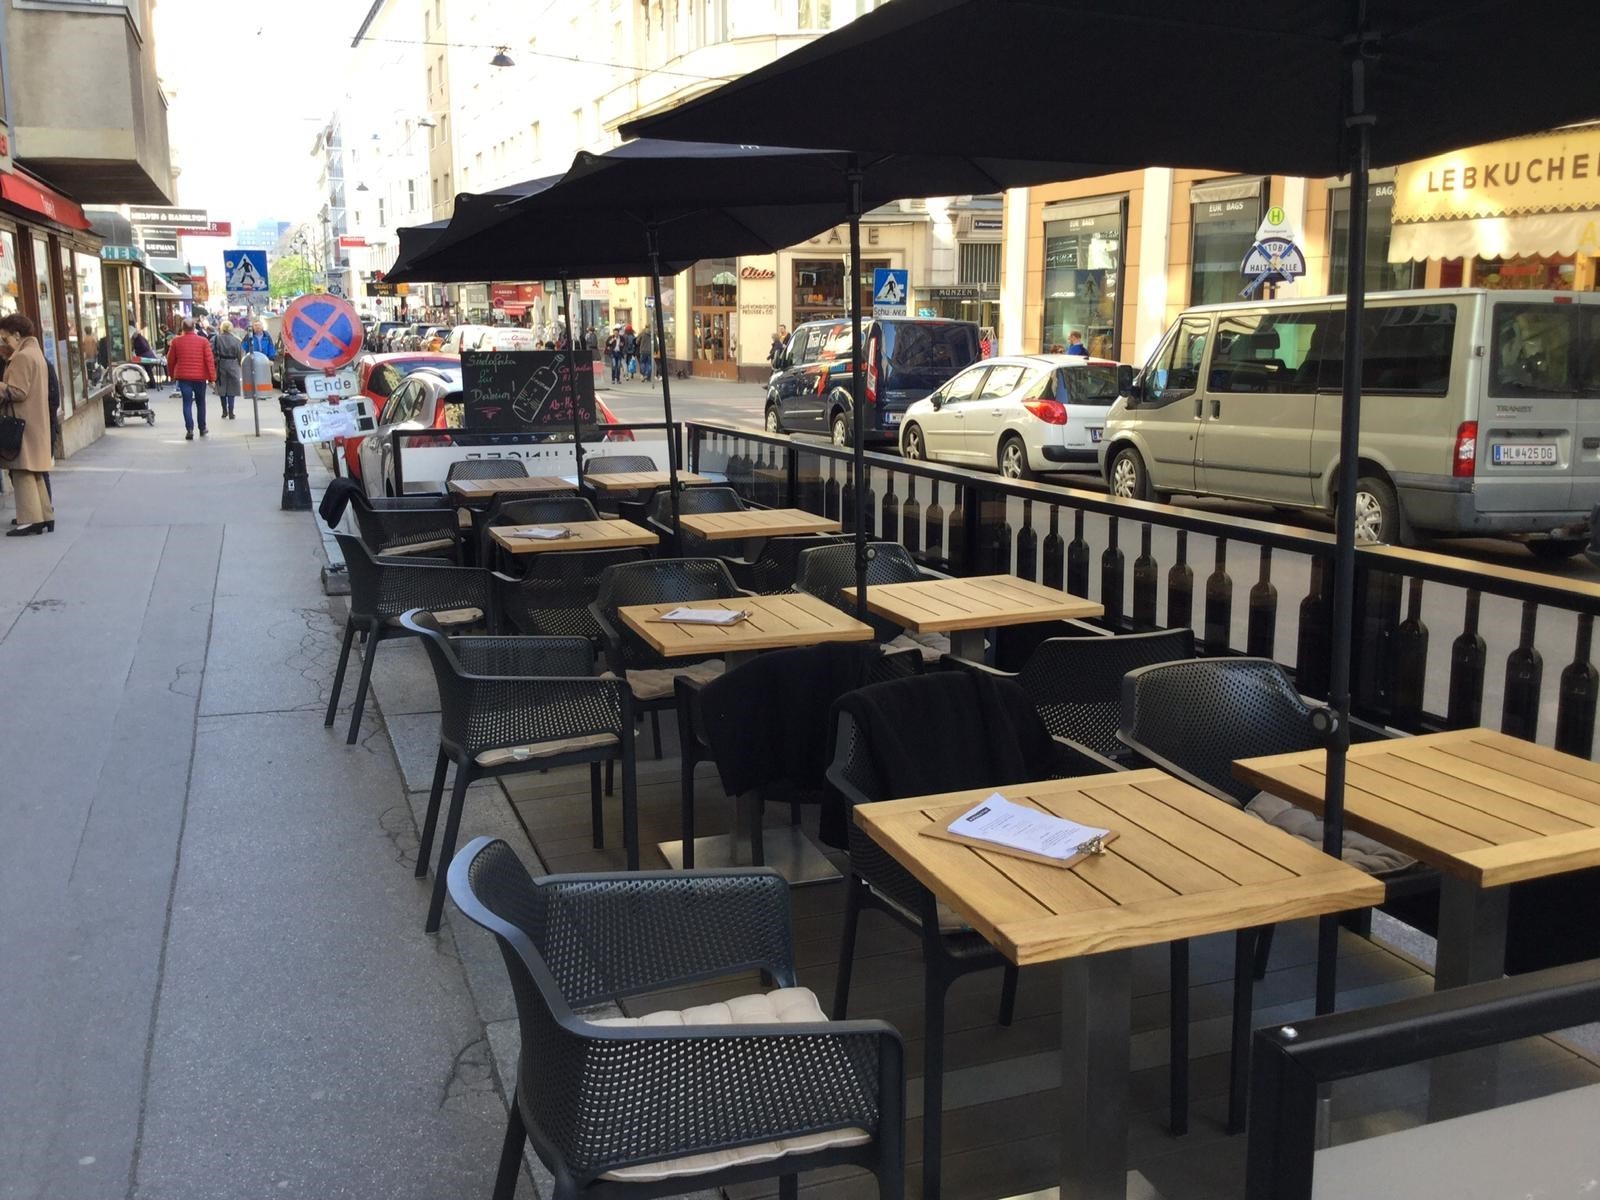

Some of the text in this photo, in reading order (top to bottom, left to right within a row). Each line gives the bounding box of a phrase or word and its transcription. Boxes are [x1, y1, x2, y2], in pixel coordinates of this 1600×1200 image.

[1375, 187, 1393, 197] BAG
[1226, 202, 1244, 211] BAGS
[1272, 210, 1280, 222] H
[741, 266, 775, 280] Aida
[313, 379, 352, 393] Ende
[1503, 447, 1515, 460] HL
